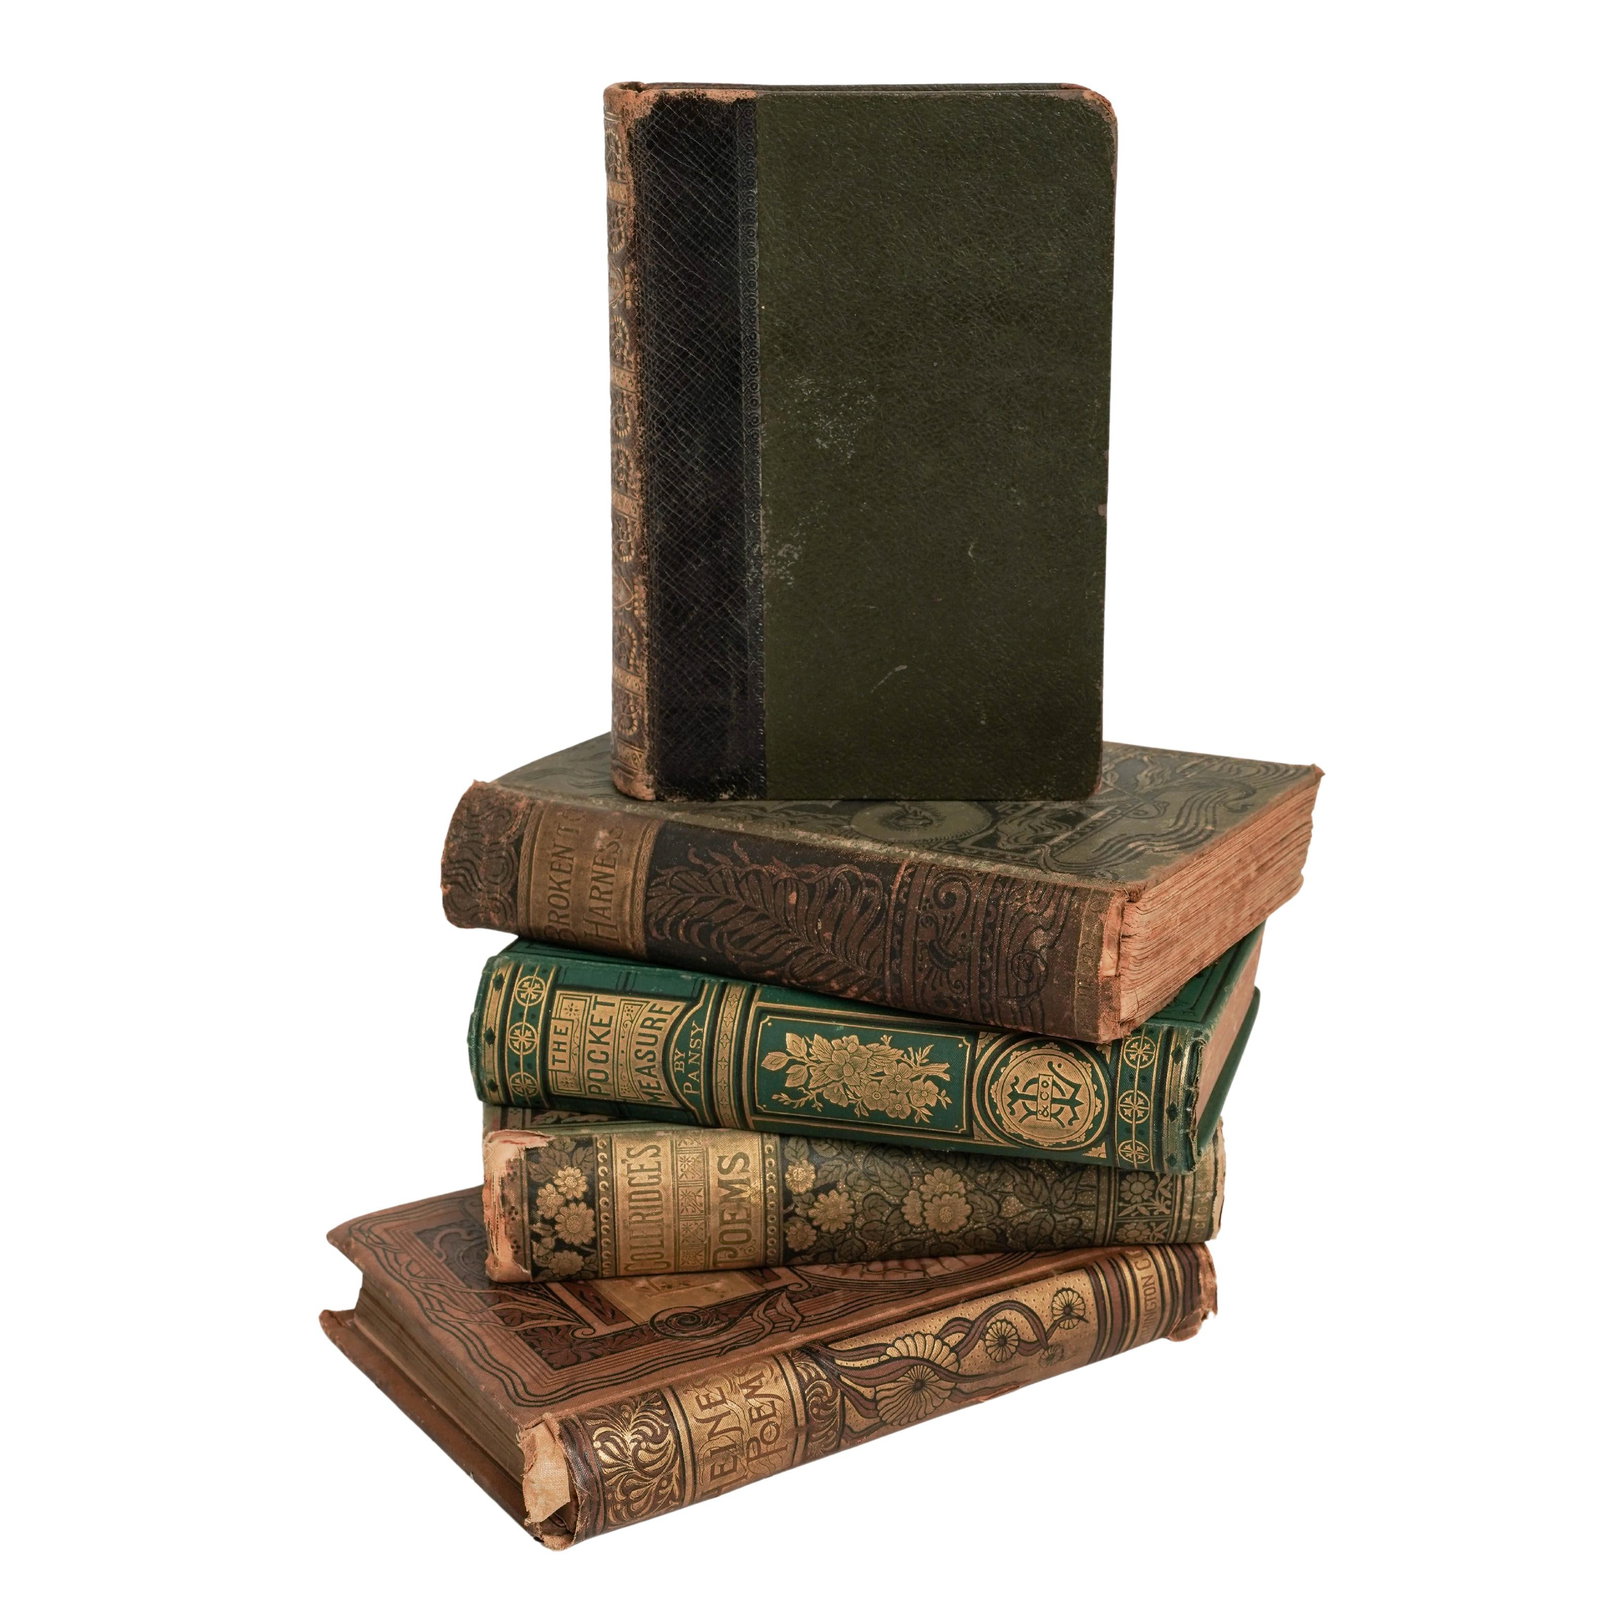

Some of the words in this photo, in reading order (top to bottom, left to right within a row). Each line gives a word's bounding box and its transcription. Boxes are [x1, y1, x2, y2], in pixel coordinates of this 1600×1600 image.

[543, 842, 577, 945] BROKEN
[551, 1025, 569, 1066] THE
[586, 995, 616, 1097] POCKET
[633, 1002, 681, 1106] MEASURE
[673, 1050, 686, 1073] BY
[683, 1020, 704, 1095] PANSY
[712, 1151, 755, 1268] POEMS
